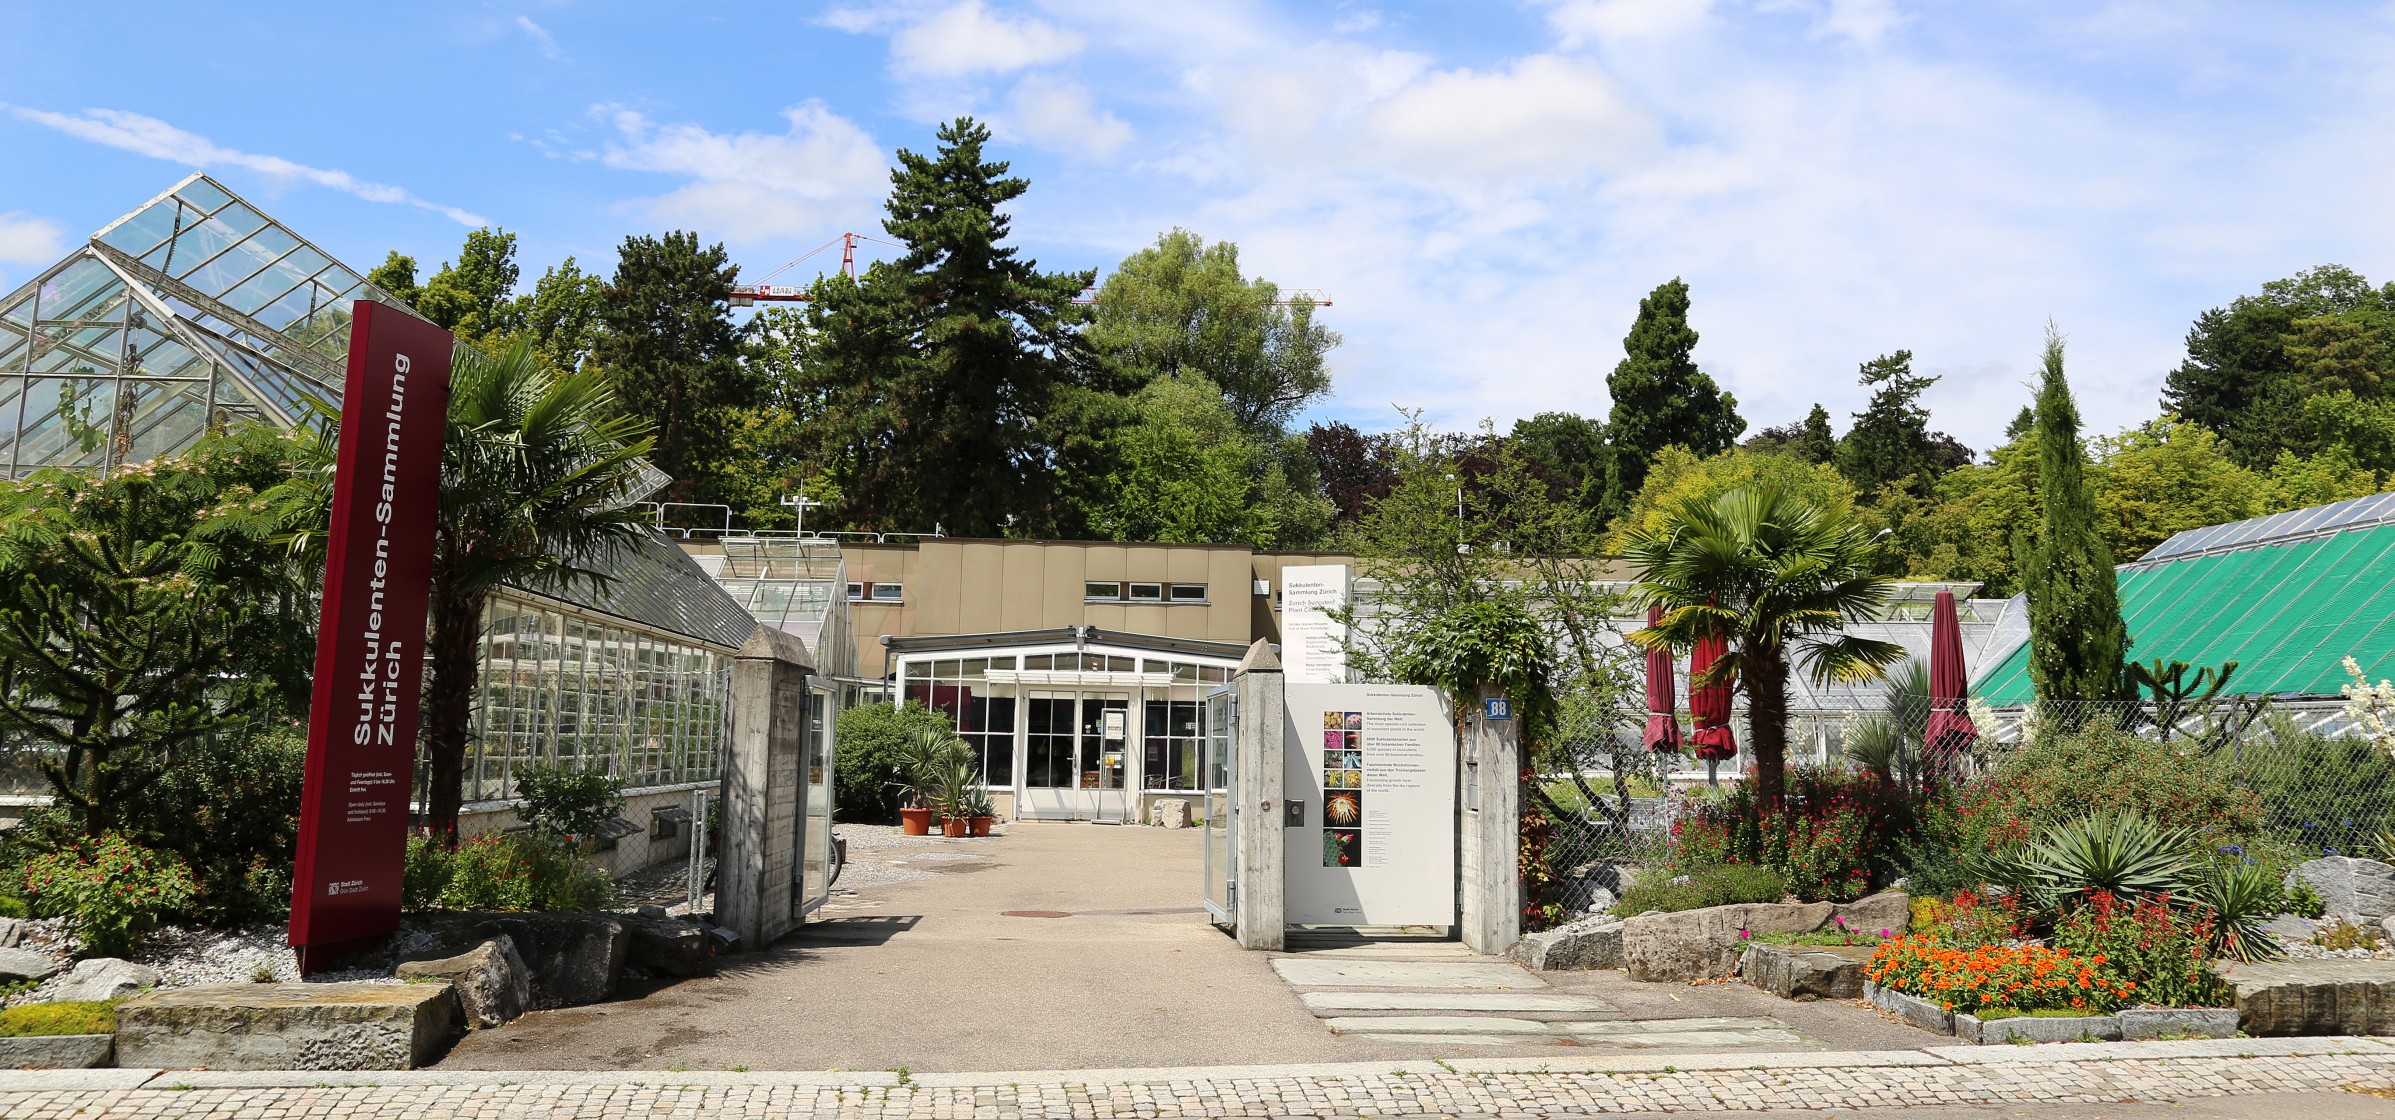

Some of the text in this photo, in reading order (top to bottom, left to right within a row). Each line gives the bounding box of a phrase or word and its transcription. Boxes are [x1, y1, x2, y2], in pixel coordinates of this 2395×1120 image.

[354, 352, 410, 746] Sukkulenten-Sammlung
[378, 640, 402, 746] Zürich
[1491, 701, 1506, 716] 88
